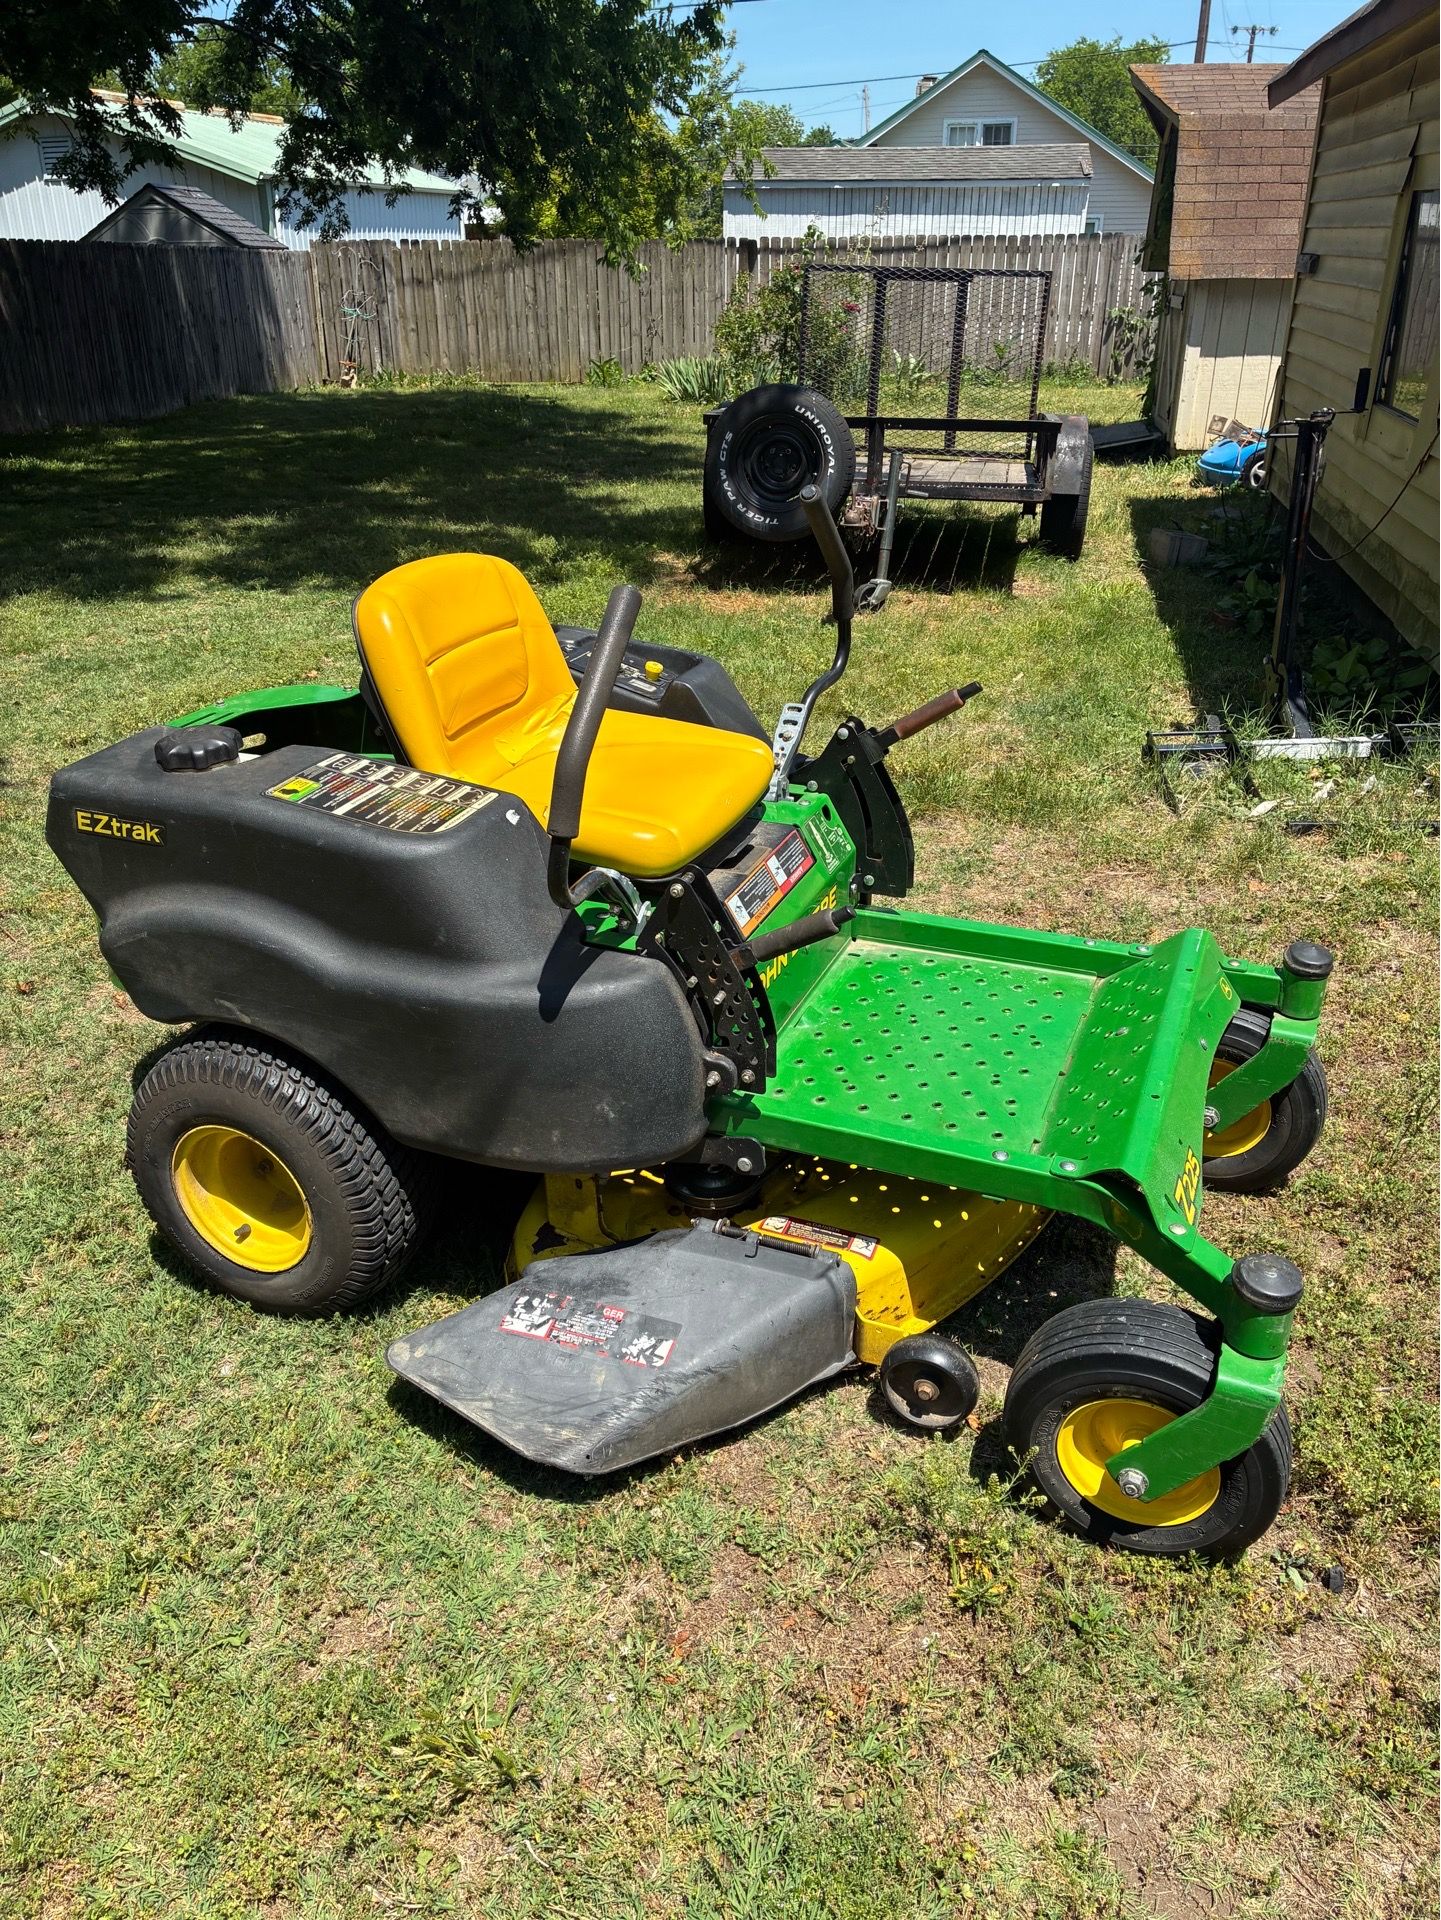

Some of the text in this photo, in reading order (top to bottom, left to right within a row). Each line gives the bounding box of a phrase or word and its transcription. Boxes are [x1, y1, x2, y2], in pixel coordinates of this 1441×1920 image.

[795, 405, 836, 477] UNIROYAL
[719, 431, 779, 525] TIGER PAW GTS
[76, 811, 160, 843] EZtrak
[760, 953, 788, 989] OHN
[1174, 1147, 1200, 1226] Z225
